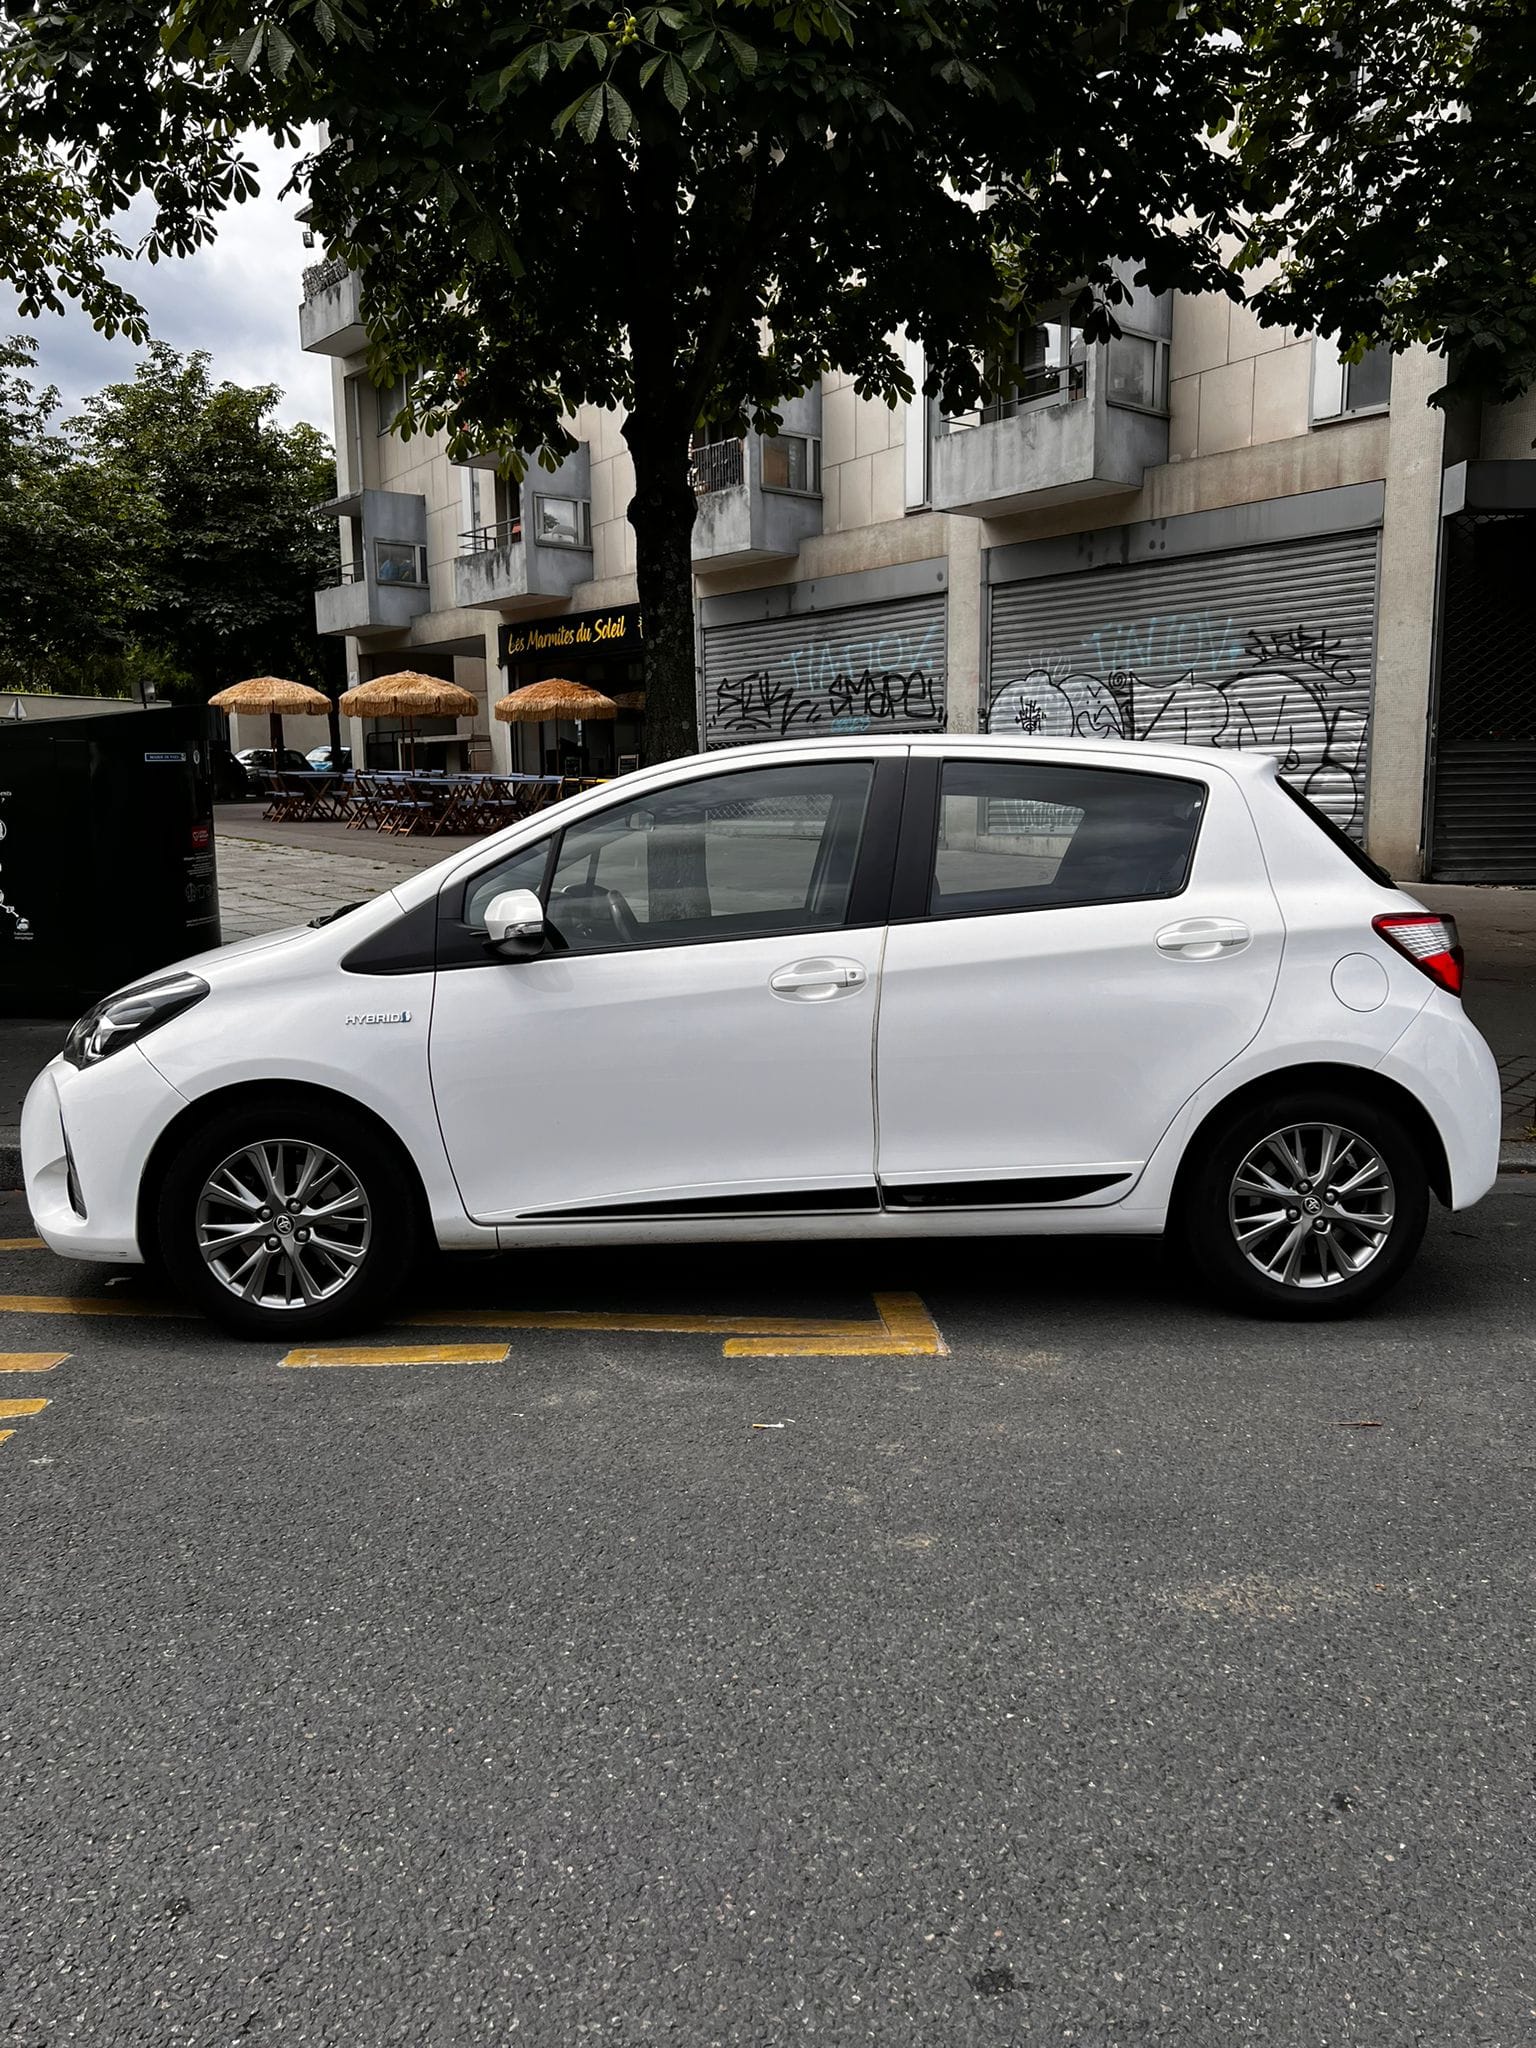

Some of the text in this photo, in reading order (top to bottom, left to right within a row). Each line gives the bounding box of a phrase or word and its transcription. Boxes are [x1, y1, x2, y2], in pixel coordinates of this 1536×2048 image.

[508, 615, 627, 655] Les Marmites du Soleil
[345, 1013, 401, 1025] HYBRID
